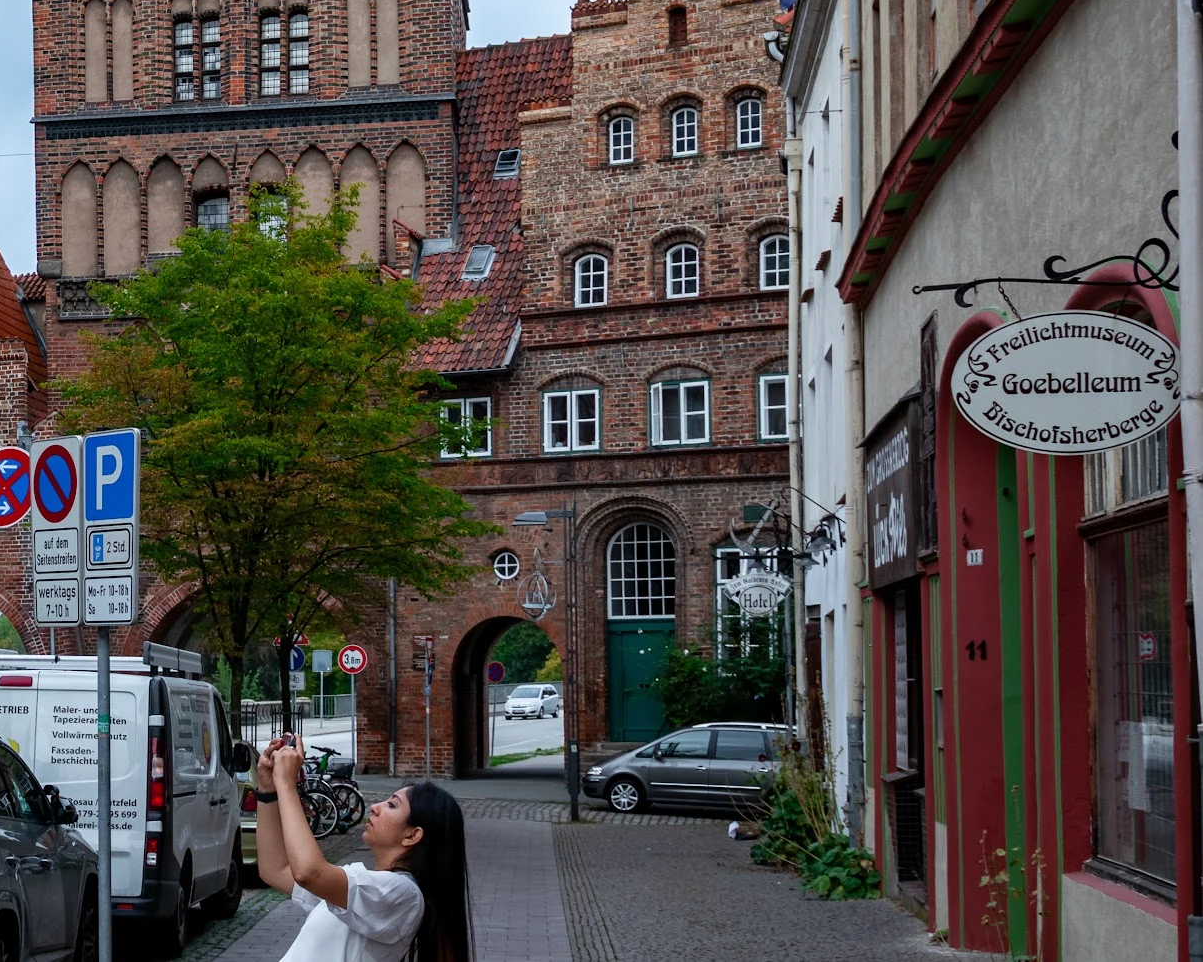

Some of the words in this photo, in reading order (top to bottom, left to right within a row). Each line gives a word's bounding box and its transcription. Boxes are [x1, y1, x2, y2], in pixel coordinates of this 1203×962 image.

[985, 321, 1156, 364] Freilichtmuseum
[1002, 372, 1142, 395] Goebelleum
[983, 399, 1164, 444] Bischofsherberge
[96, 444, 123, 511] P
[44, 536, 54, 550] auf
[56, 536, 69, 549] dem
[106, 541, 112, 553] 2
[113, 540, 127, 553] Std.
[37, 552, 77, 566] Seitenstreifen
[970, 552, 979, 563] 11
[38, 584, 77, 601] werktags
[88, 585, 107, 598] Mo-Fr
[743, 593, 773, 608] Hotel
[45, 603, 63, 618] 7-10
[64, 603, 70, 617] h
[88, 603, 96, 615] Sa
[965, 640, 988, 661] 11
[53, 705, 81, 714] Maler-
[51, 746, 95, 755] Fassaden-
